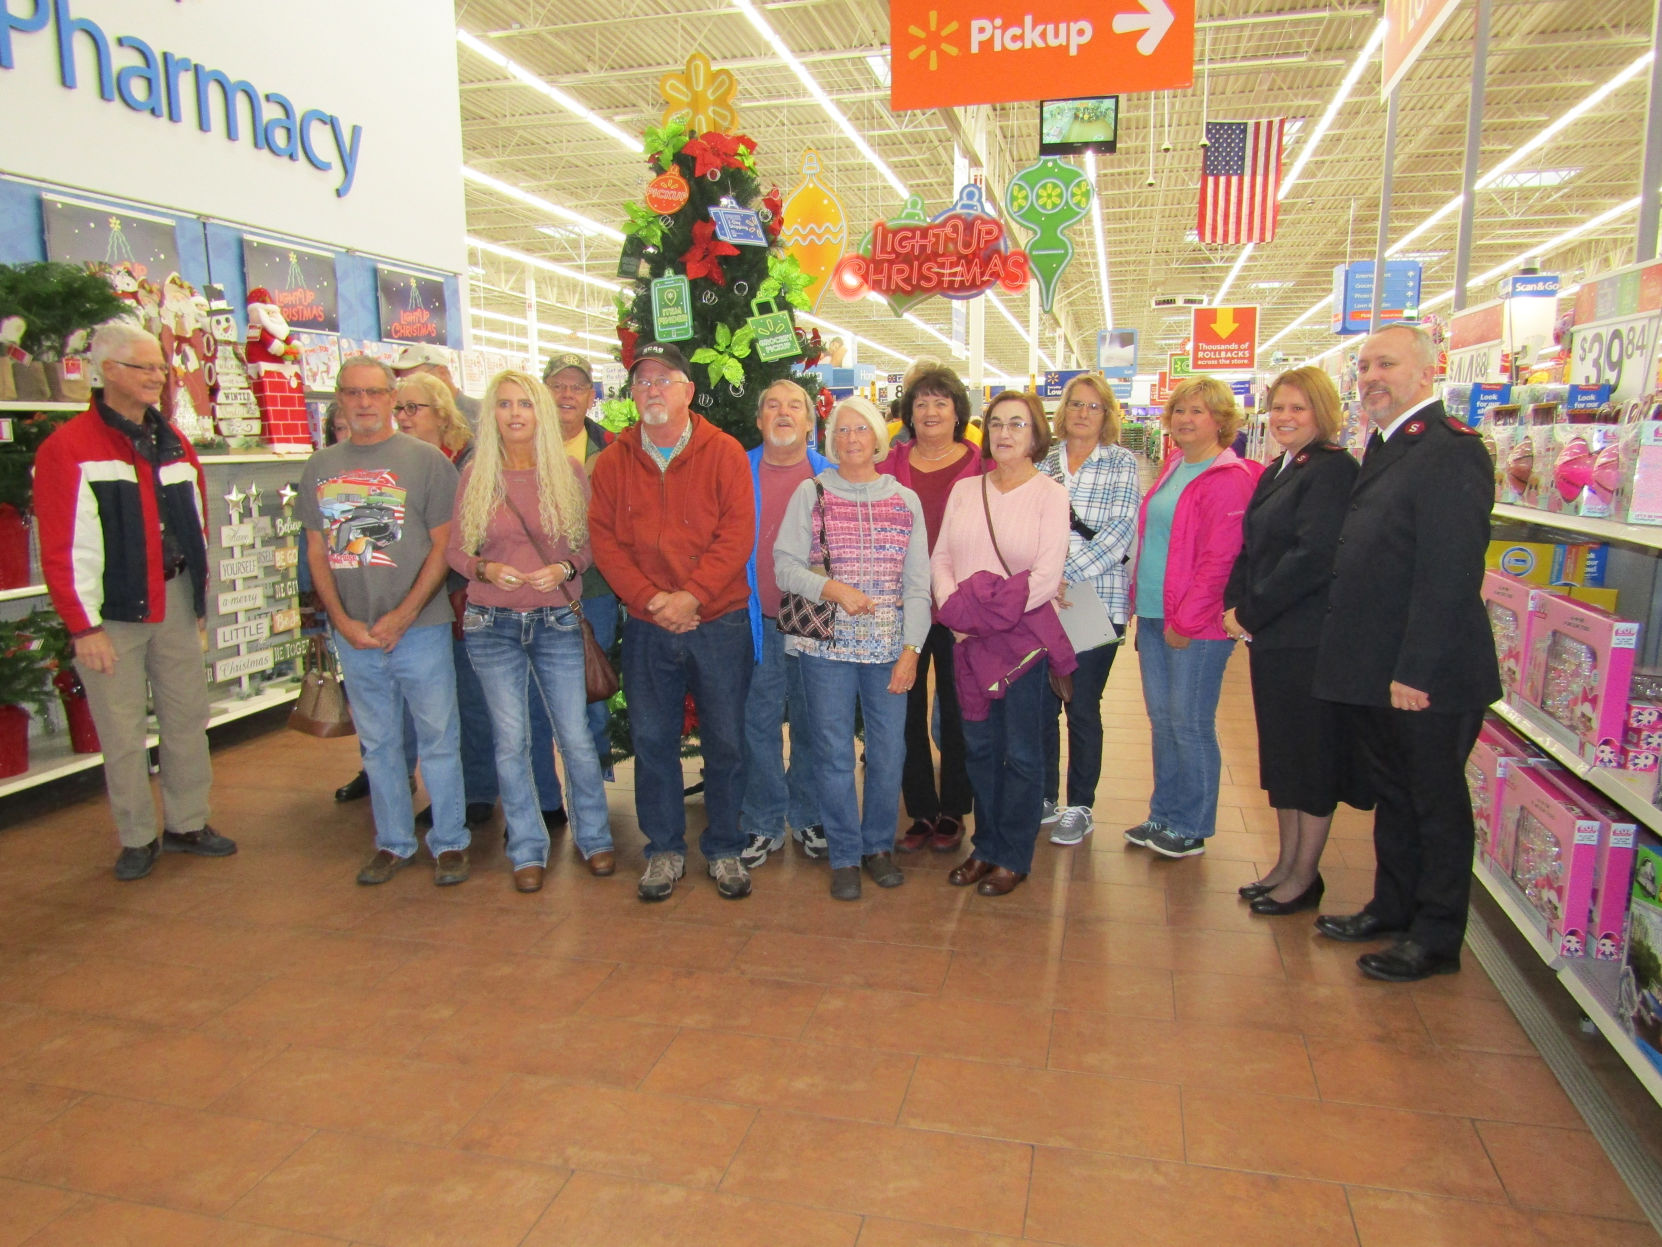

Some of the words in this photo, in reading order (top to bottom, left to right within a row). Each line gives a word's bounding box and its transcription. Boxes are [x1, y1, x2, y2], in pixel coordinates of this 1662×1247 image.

[970, 15, 1093, 56] Pickup
[0, 0, 362, 197] Pharmacy
[876, 228, 951, 260] LIGHT
[946, 219, 999, 254] UP
[838, 254, 1025, 290] CHRISTMAS
[1516, 281, 1560, 292] Scan&Go
[282, 305, 325, 322] RISTMAS
[1198, 343, 1238, 351] Thousands
[1239, 342, 1249, 350] of
[1198, 350, 1250, 358] ROLLBACKS
[276, 517, 302, 536] Believ
[222, 559, 256, 577] YOURSELF
[223, 622, 264, 642] LITTLE
[221, 656, 269, 677] Christmas
